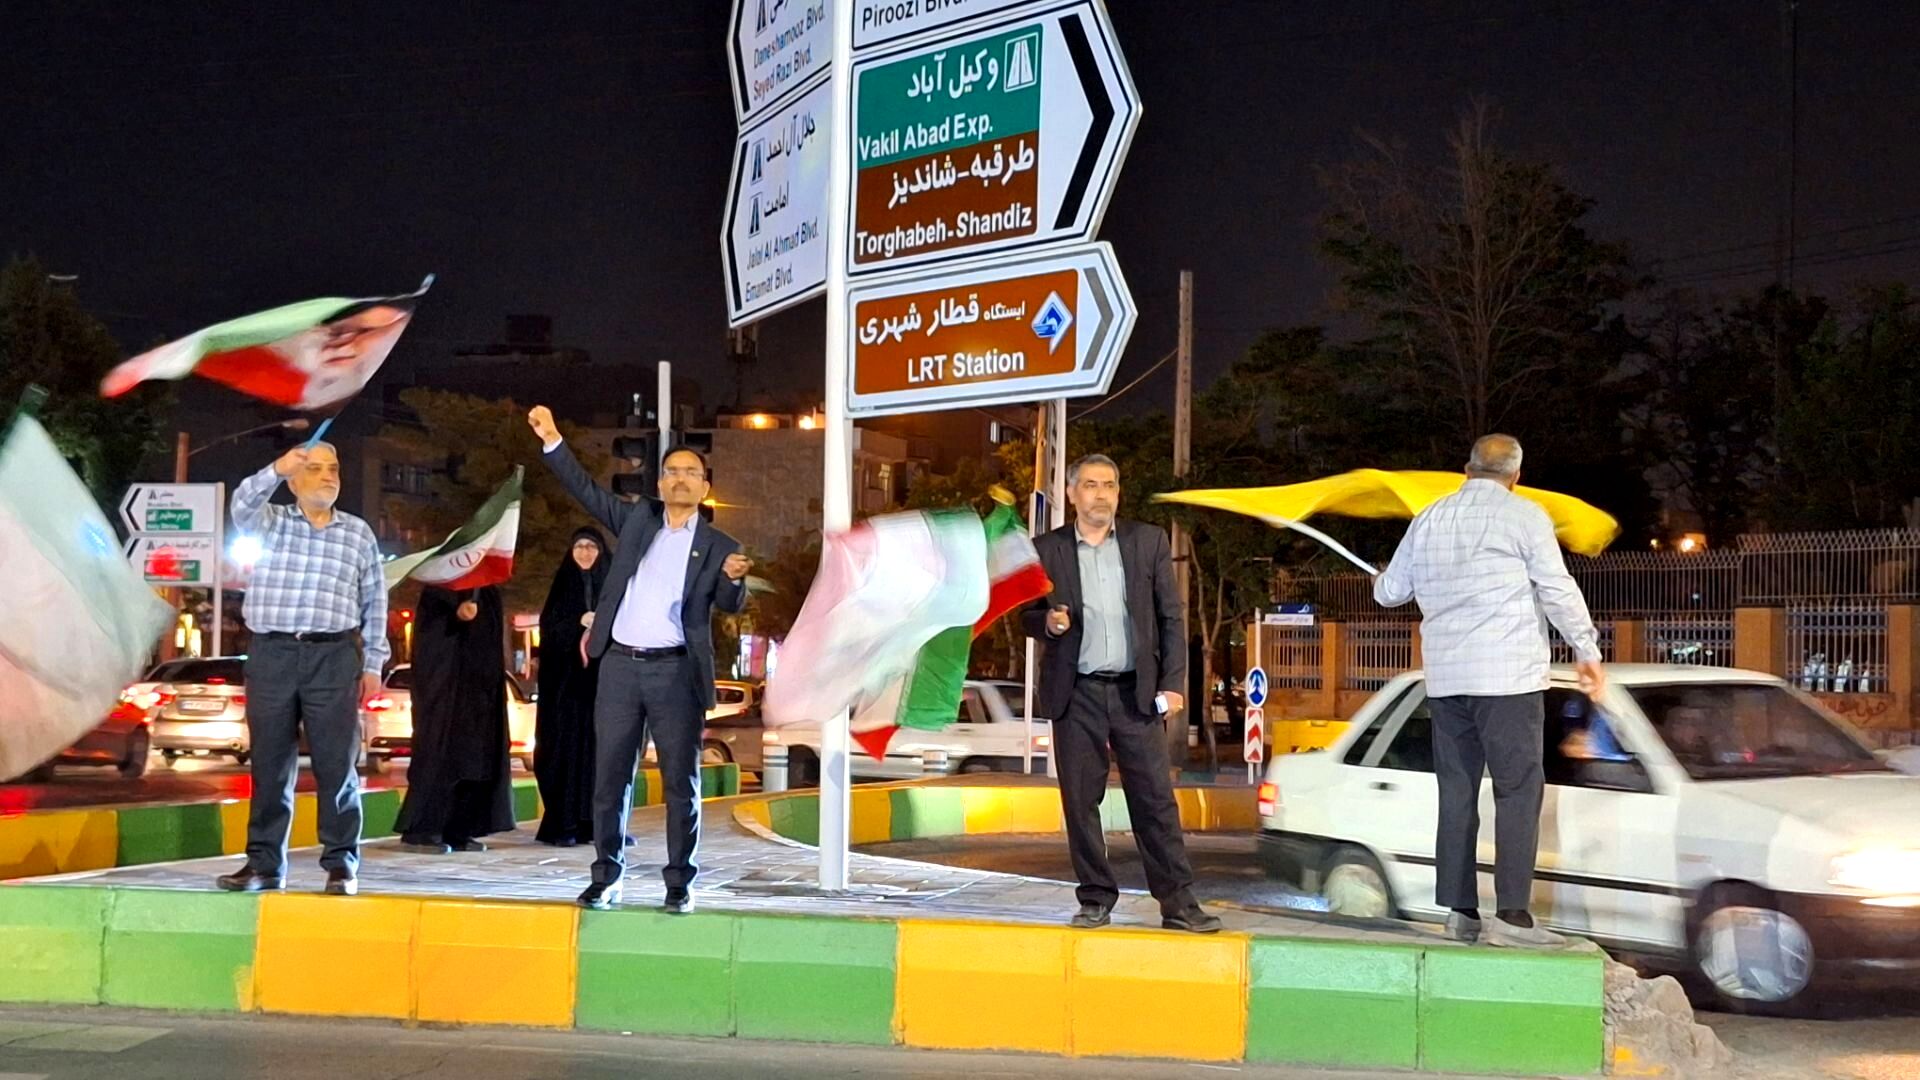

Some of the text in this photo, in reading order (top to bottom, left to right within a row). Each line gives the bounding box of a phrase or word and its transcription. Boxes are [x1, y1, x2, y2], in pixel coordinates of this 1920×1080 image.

[862, 0, 919, 31] Piroozi
[907, 48, 999, 102] وکیل آباد
[858, 113, 994, 161] Vakil Abad Exp.
[859, 293, 1026, 345] ایستگاه قطار شهری
[907, 348, 1025, 384] LRT Station
